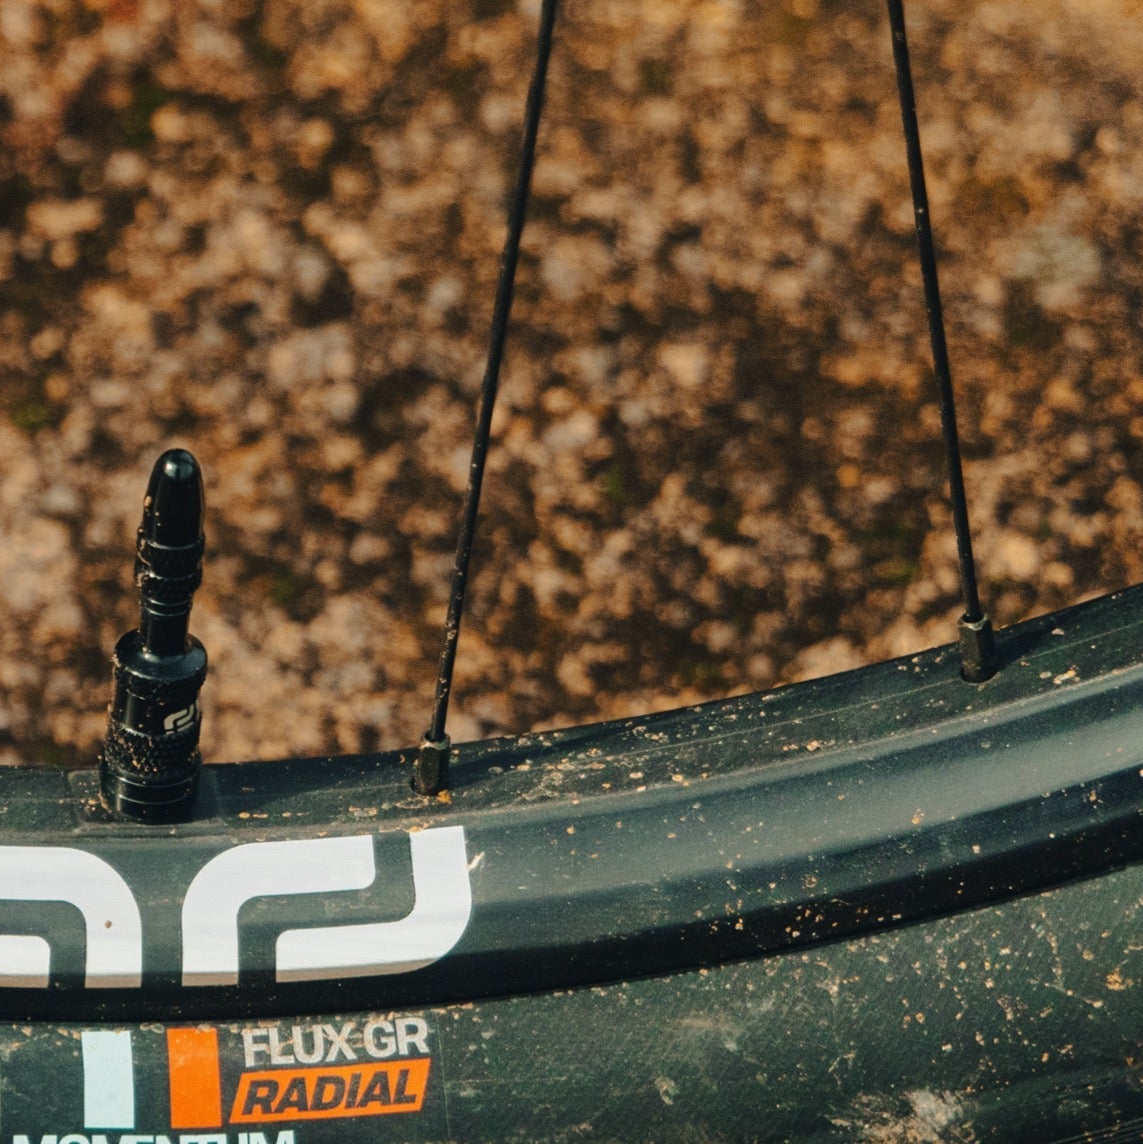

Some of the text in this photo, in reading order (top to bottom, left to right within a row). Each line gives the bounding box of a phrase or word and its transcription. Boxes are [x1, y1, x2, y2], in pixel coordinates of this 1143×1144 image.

[242, 1017, 429, 1067] FLUX GR
[242, 1069, 417, 1115] RADIAL
